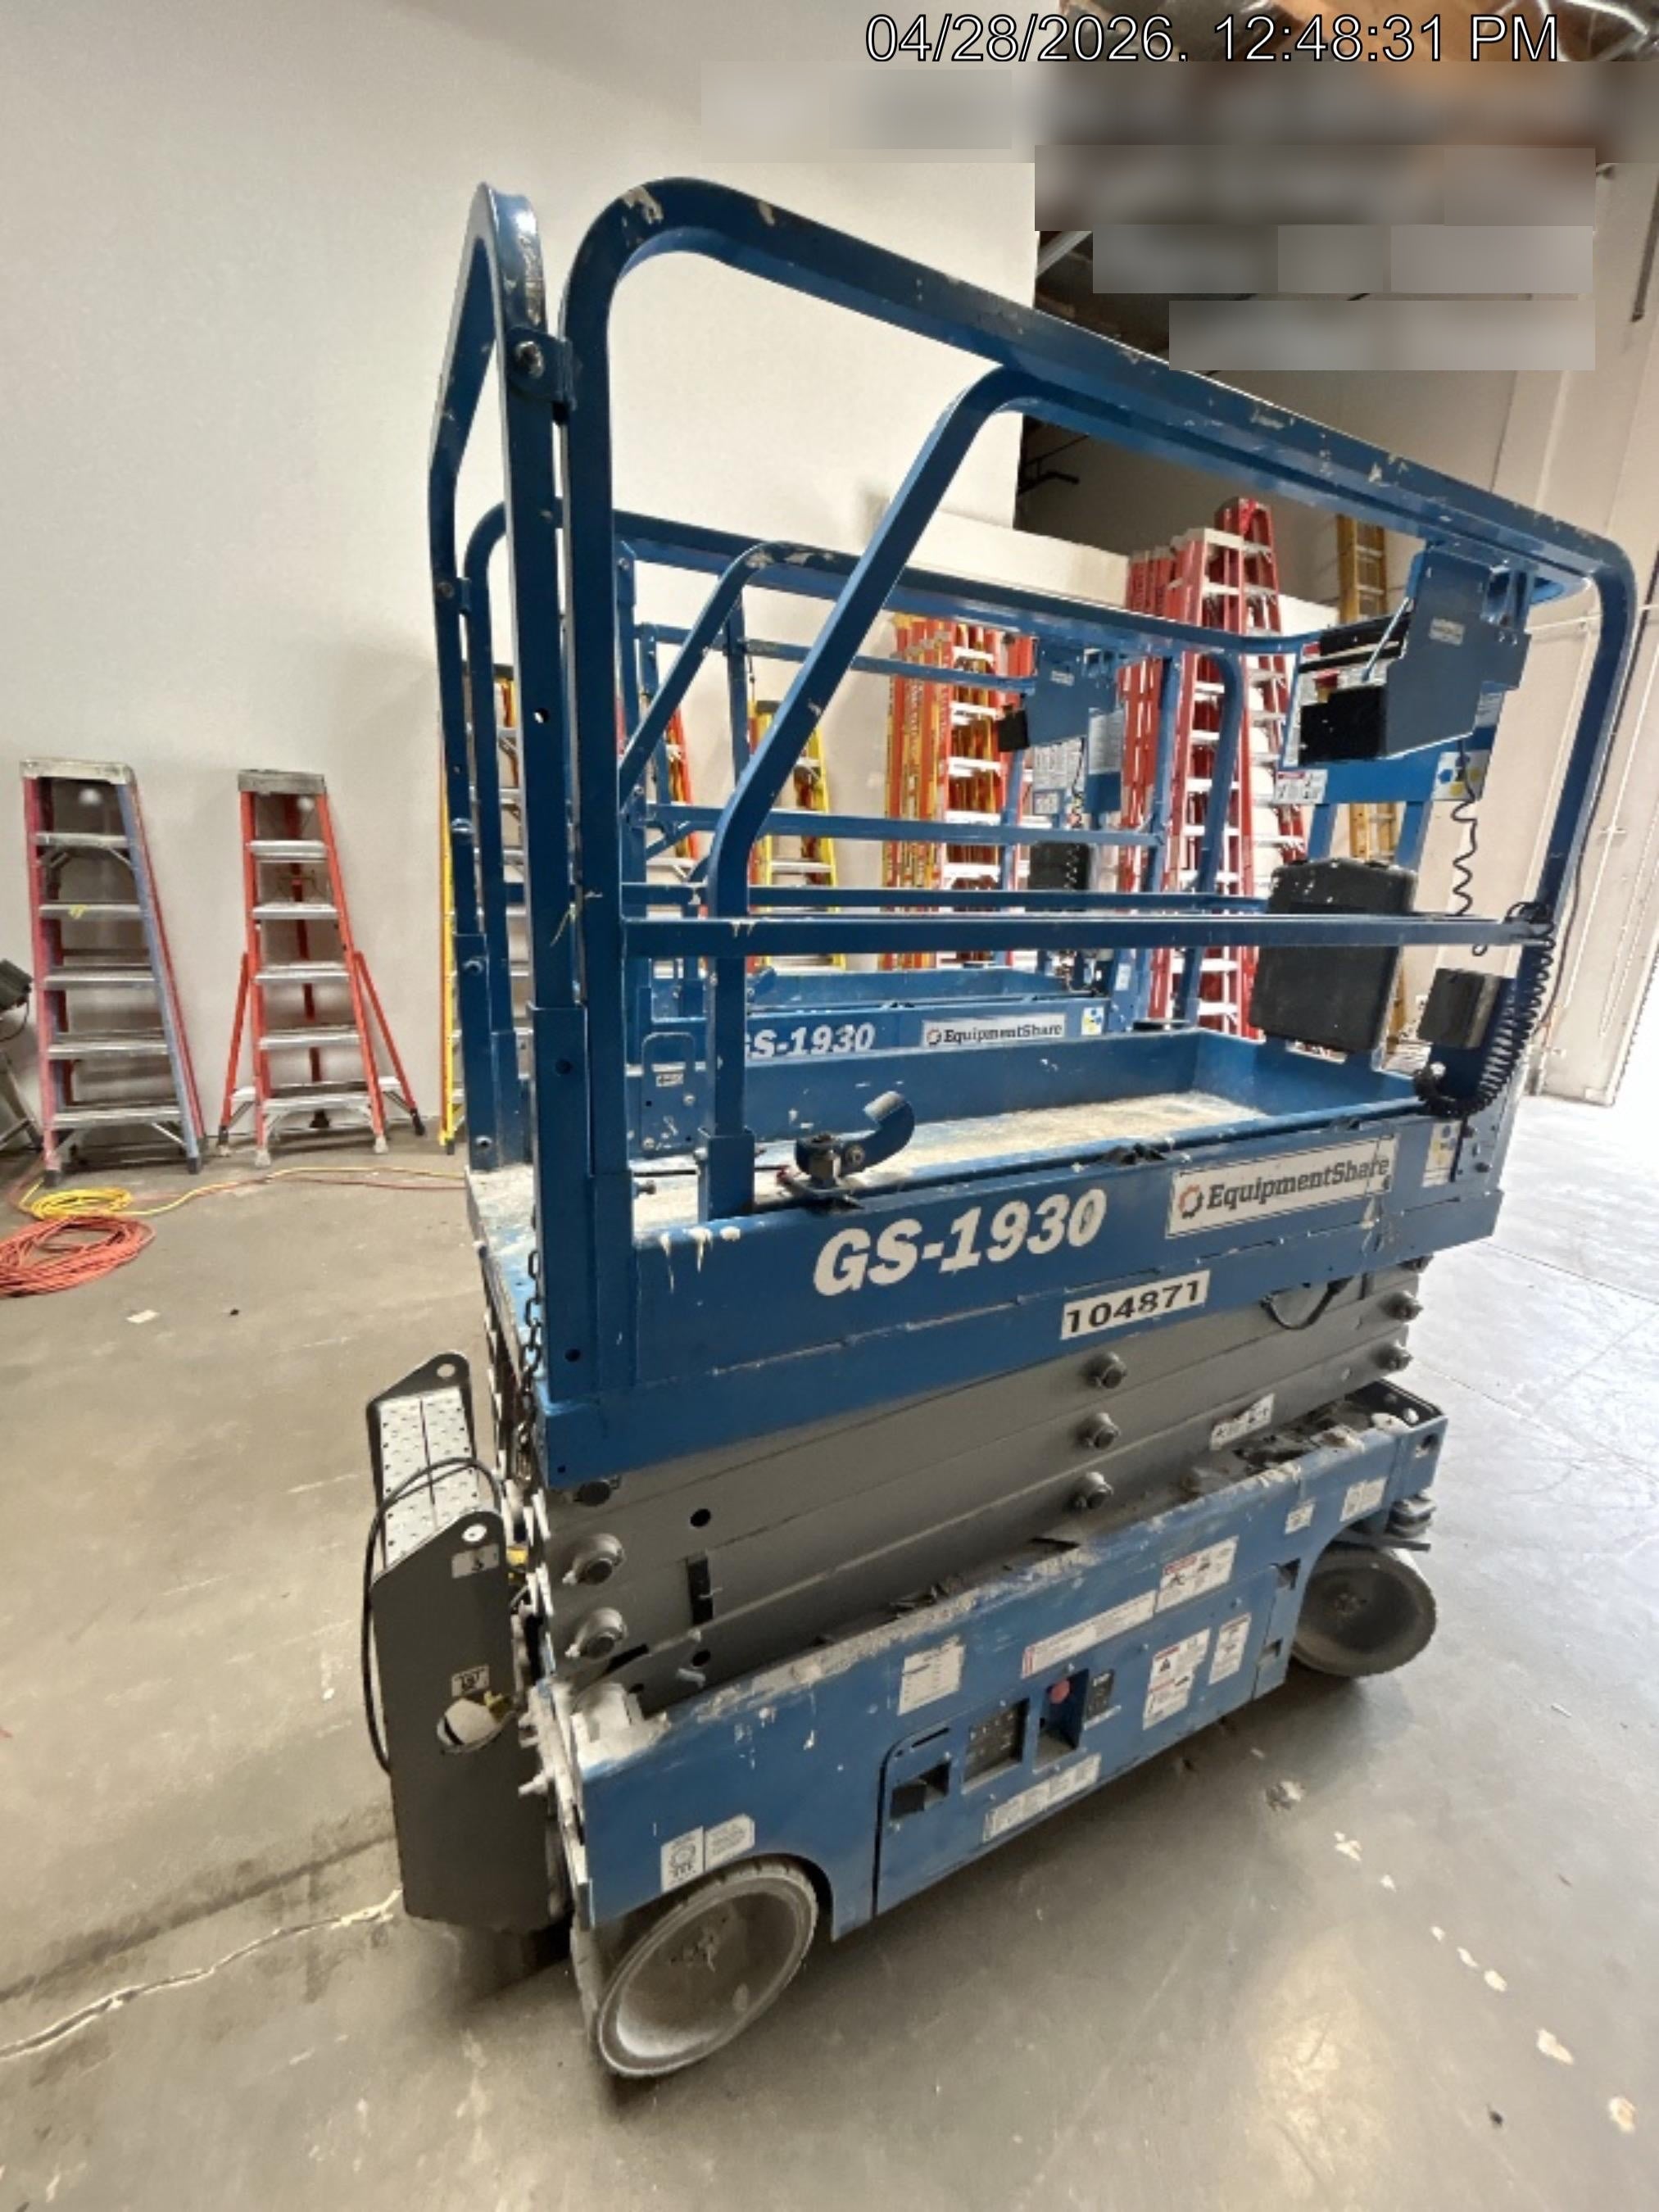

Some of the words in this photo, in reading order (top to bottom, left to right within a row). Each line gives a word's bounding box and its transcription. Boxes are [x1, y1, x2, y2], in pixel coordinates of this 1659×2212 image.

[745, 1022, 875, 1058] S-1930
[944, 1023, 1062, 1045] EquipmentShare
[1207, 1155, 1389, 1210] EquipmentShare
[813, 1188, 1106, 1296] GS-1930
[1067, 1280, 1199, 1333] 104871
